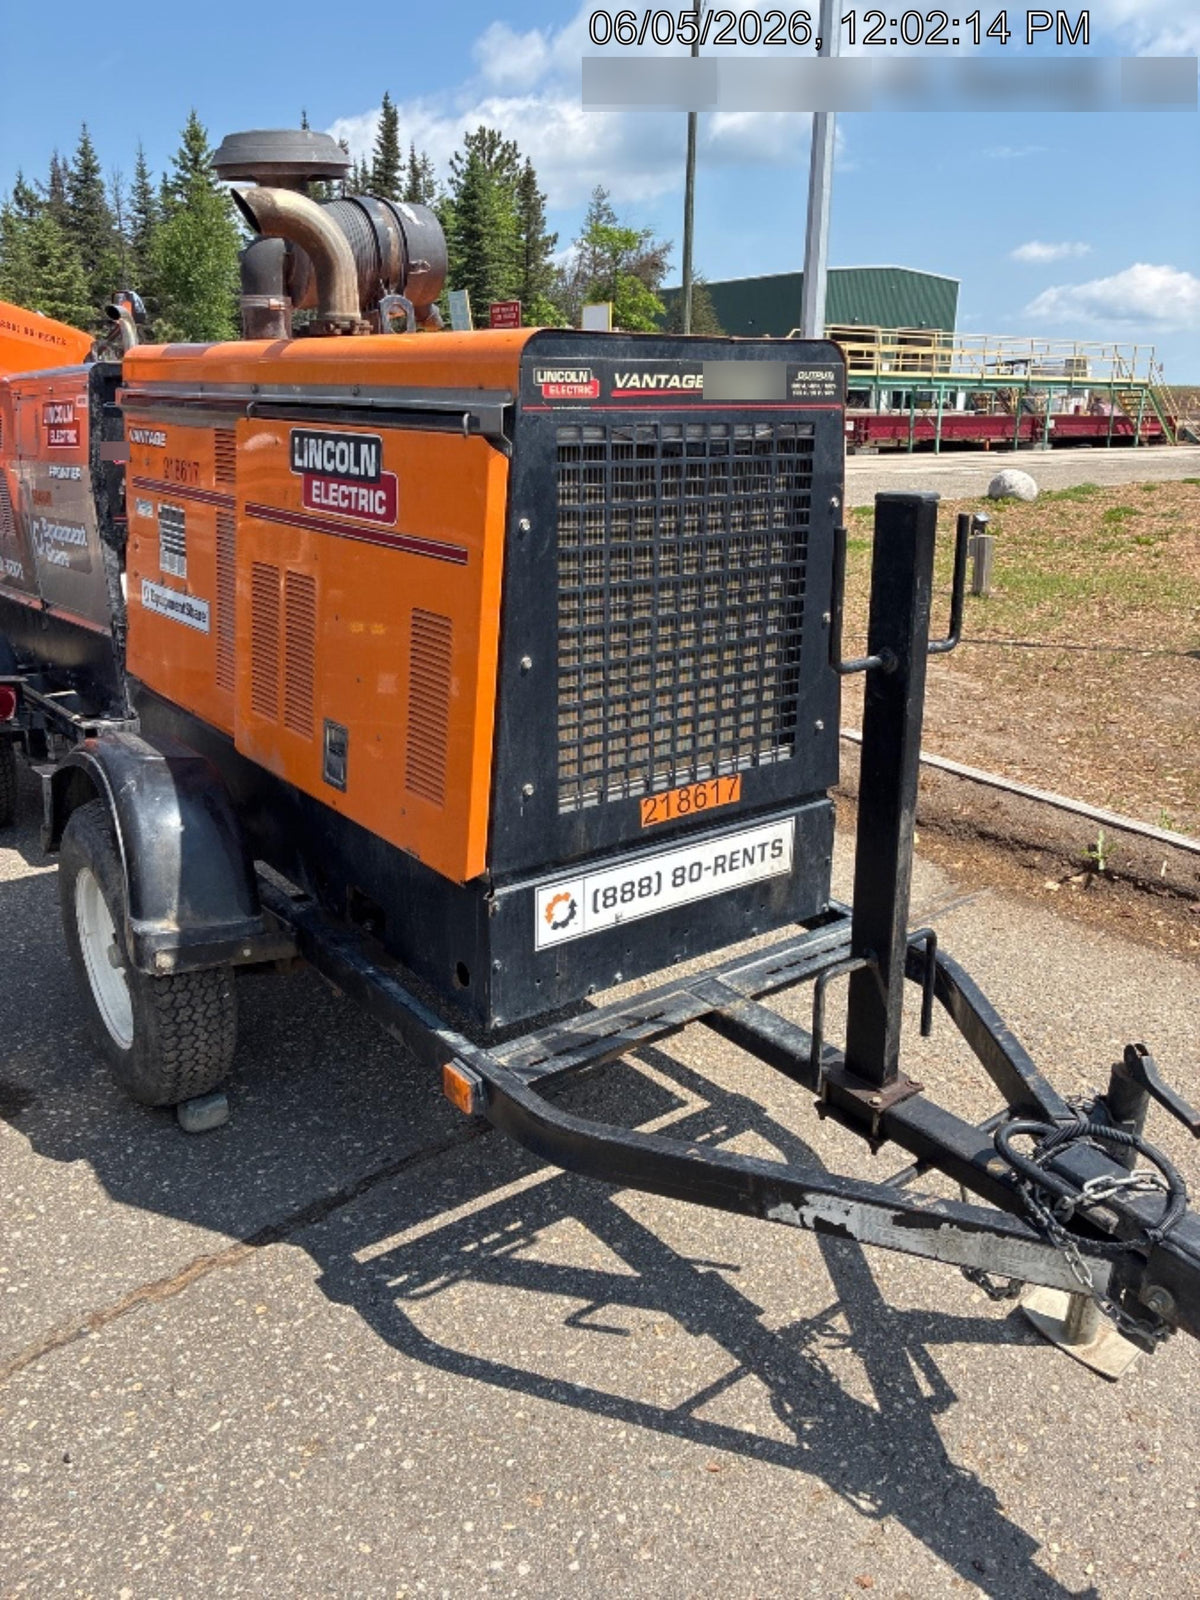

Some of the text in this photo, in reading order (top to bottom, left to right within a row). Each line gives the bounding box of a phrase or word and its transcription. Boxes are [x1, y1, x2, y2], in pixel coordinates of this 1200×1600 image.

[536, 370, 588, 384] LINCOLN
[549, 384, 595, 395] ELECTRIC
[614, 372, 704, 389] VANTAGE
[129, 428, 167, 447] VANTAGE
[293, 436, 377, 478] LINCOLN
[311, 479, 388, 516] ELECTRIC
[643, 775, 739, 824] 218617
[592, 838, 784, 914] (888) 80-RENTS
